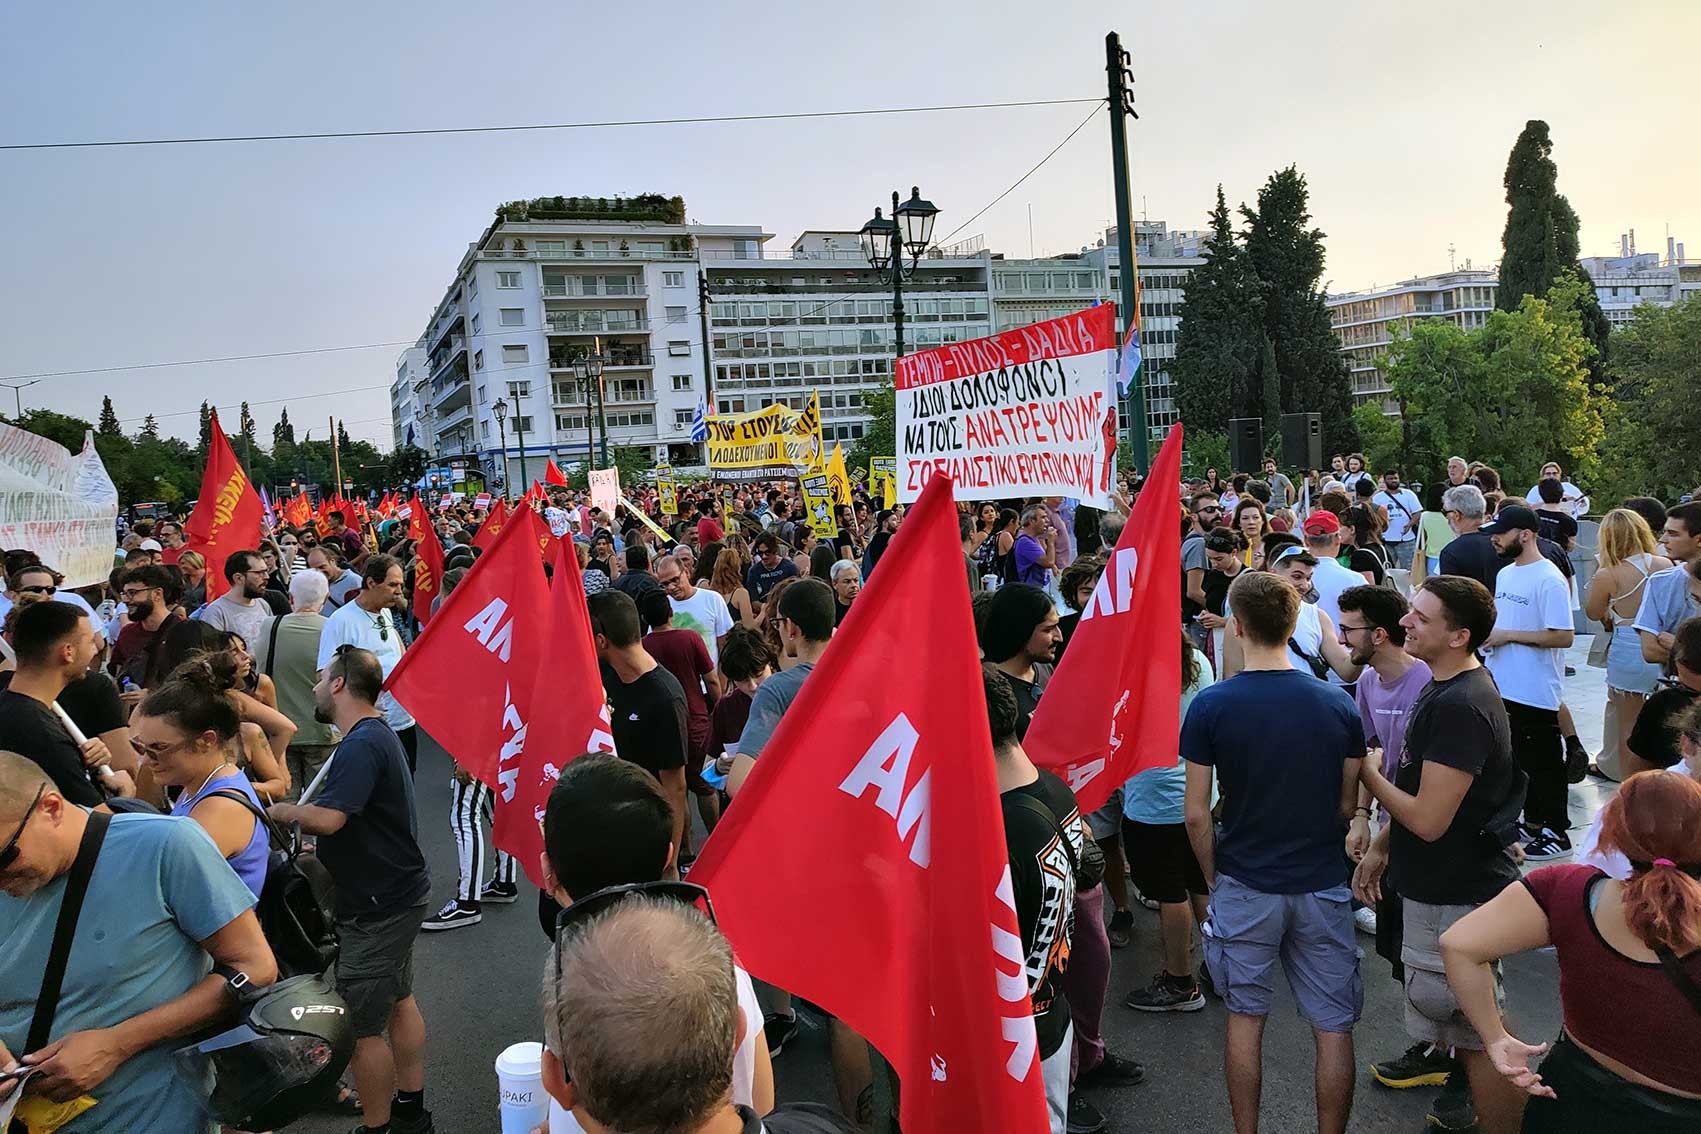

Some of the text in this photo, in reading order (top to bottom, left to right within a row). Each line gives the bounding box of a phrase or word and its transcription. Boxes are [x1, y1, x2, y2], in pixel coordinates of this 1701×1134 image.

[913, 359, 1067, 419] ΙΔΙΟΙ ΔΟΛΟΦΟΝΟΙ
[904, 424, 924, 455] ΝΑ
[928, 416, 962, 453] ΤΟΥΣ
